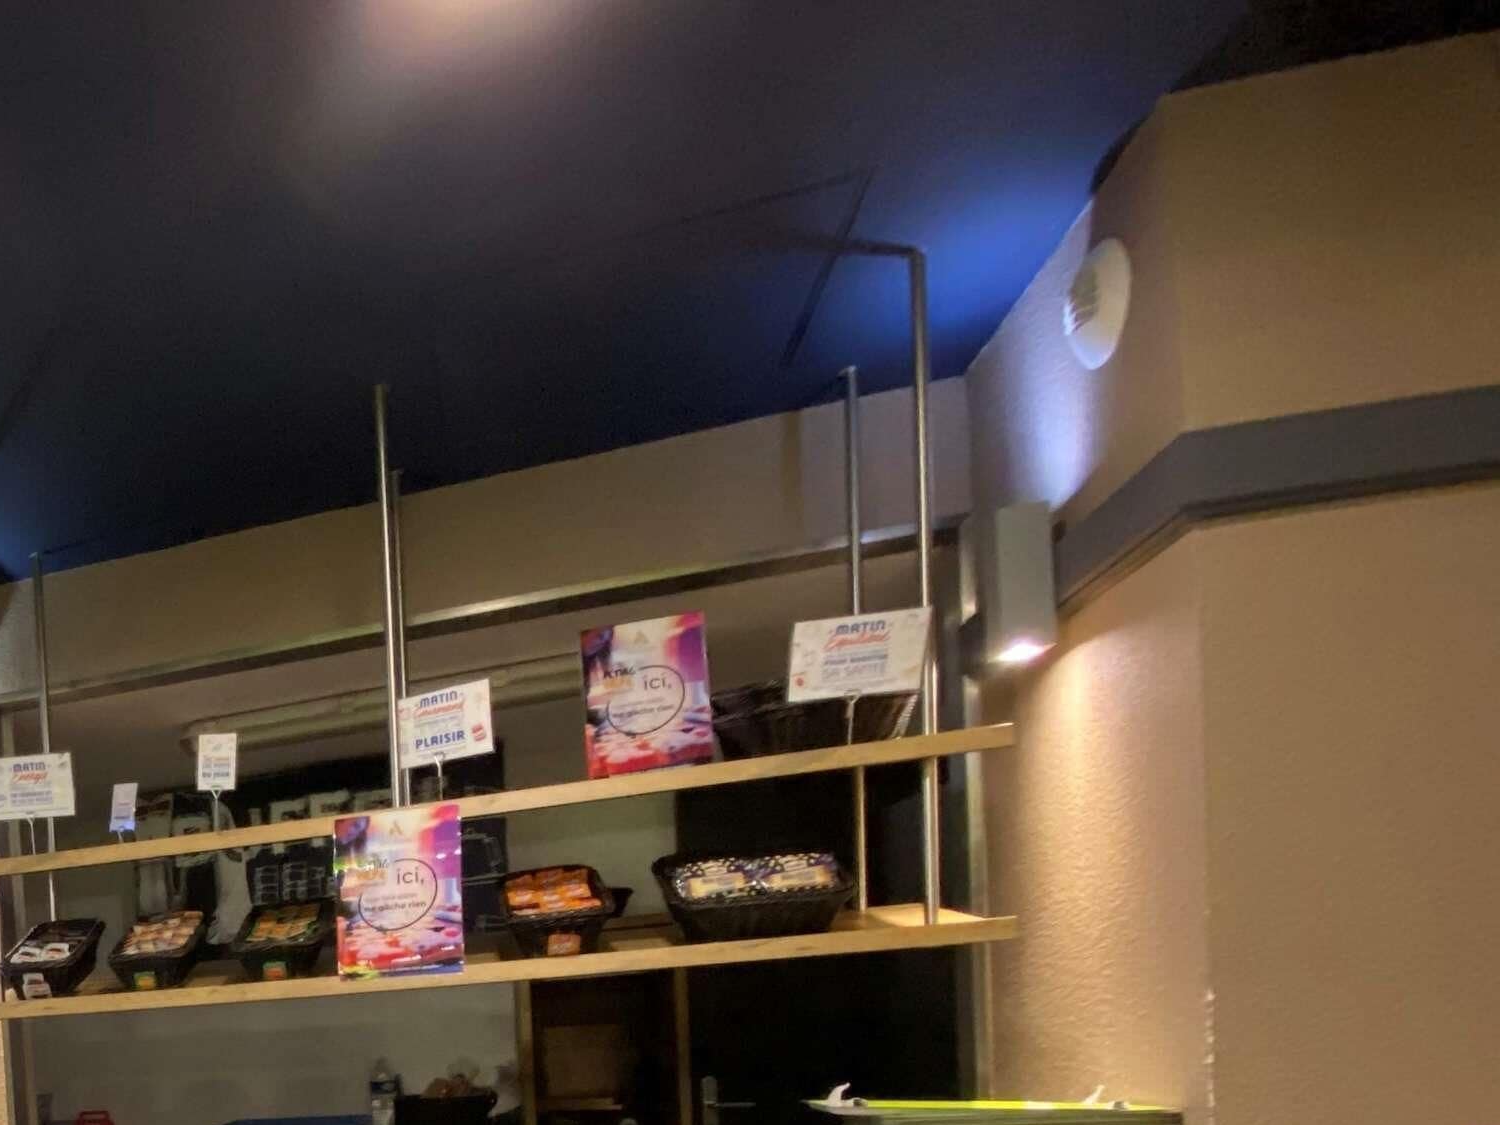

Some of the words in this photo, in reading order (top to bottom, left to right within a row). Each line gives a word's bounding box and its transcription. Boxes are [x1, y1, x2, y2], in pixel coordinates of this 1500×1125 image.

[836, 620, 886, 635] MATIN
[419, 691, 458, 708] MATIN
[415, 730, 466, 749] PLAISIR
[396, 866, 425, 885] ici,
